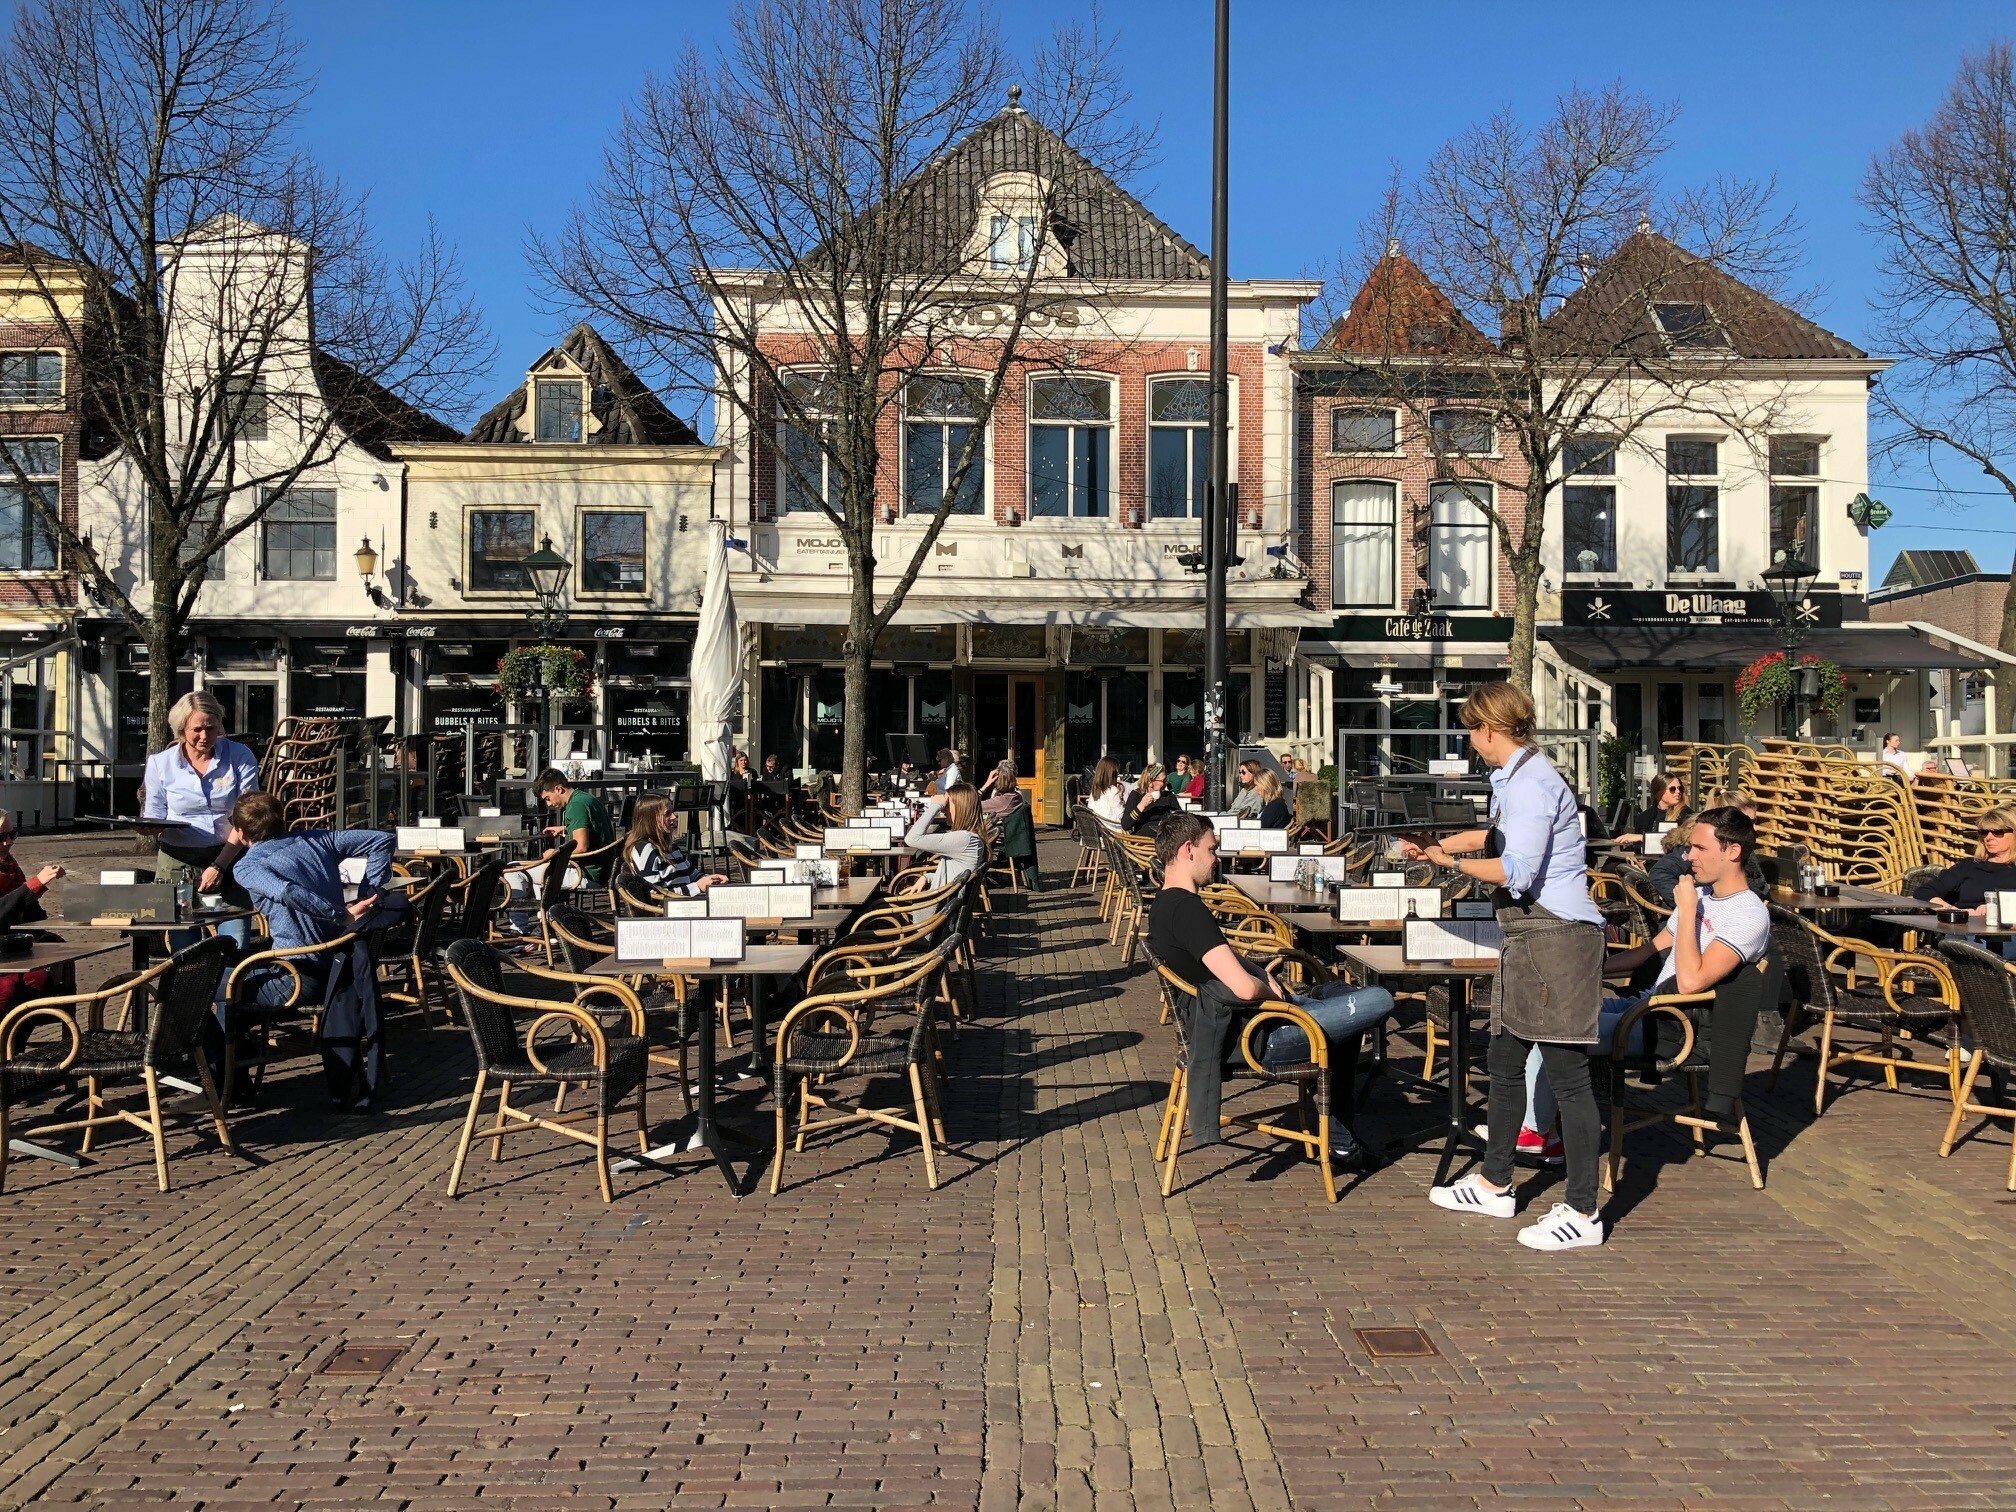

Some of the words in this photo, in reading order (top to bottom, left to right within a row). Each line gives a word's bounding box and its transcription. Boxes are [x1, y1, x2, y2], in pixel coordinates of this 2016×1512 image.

[1665, 593, 1691, 614] De
[1691, 594, 1746, 615] Waag
[1385, 618, 1410, 637] Café
[1412, 619, 1422, 632] de
[1424, 618, 1453, 637] Zaak
[435, 717, 468, 726] BUBBELS
[617, 717, 650, 726] BUBBELS
[652, 717, 657, 726] &
[660, 717, 680, 726] BITES
